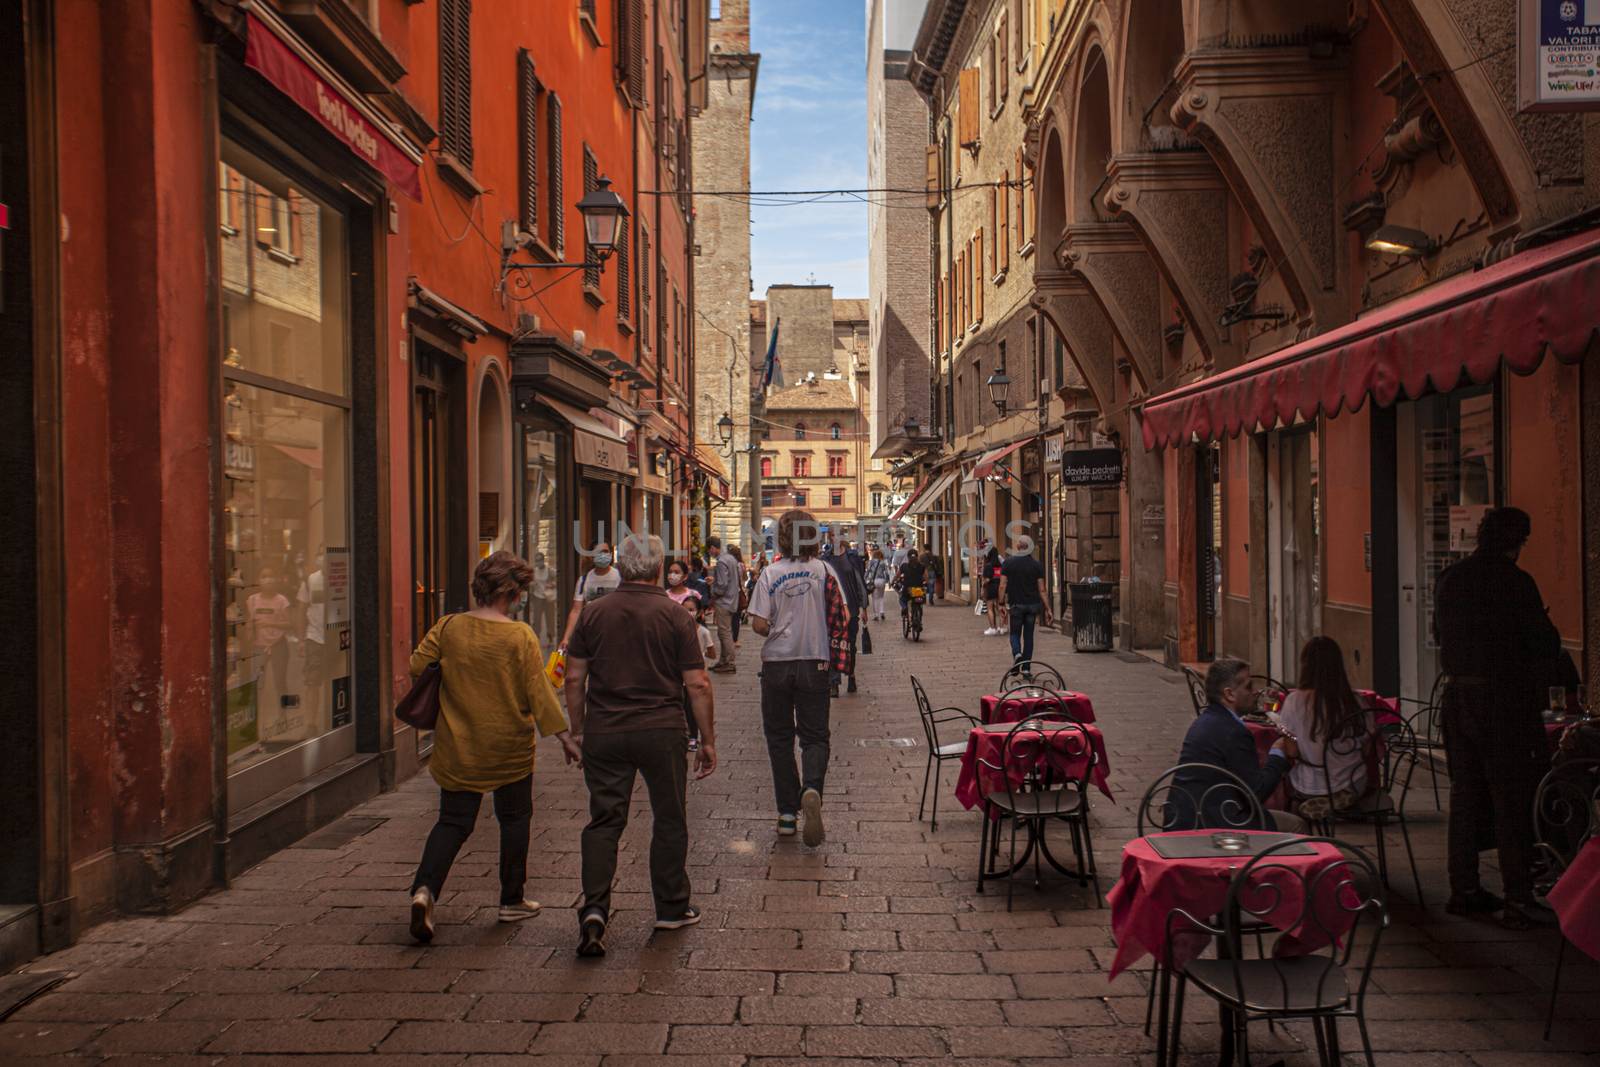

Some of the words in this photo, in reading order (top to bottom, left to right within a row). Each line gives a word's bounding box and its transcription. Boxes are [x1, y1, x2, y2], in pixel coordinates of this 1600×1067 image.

[1567, 26, 1600, 35] TABA
[1548, 36, 1592, 45] VALORI
[1065, 465, 1090, 476] davide
